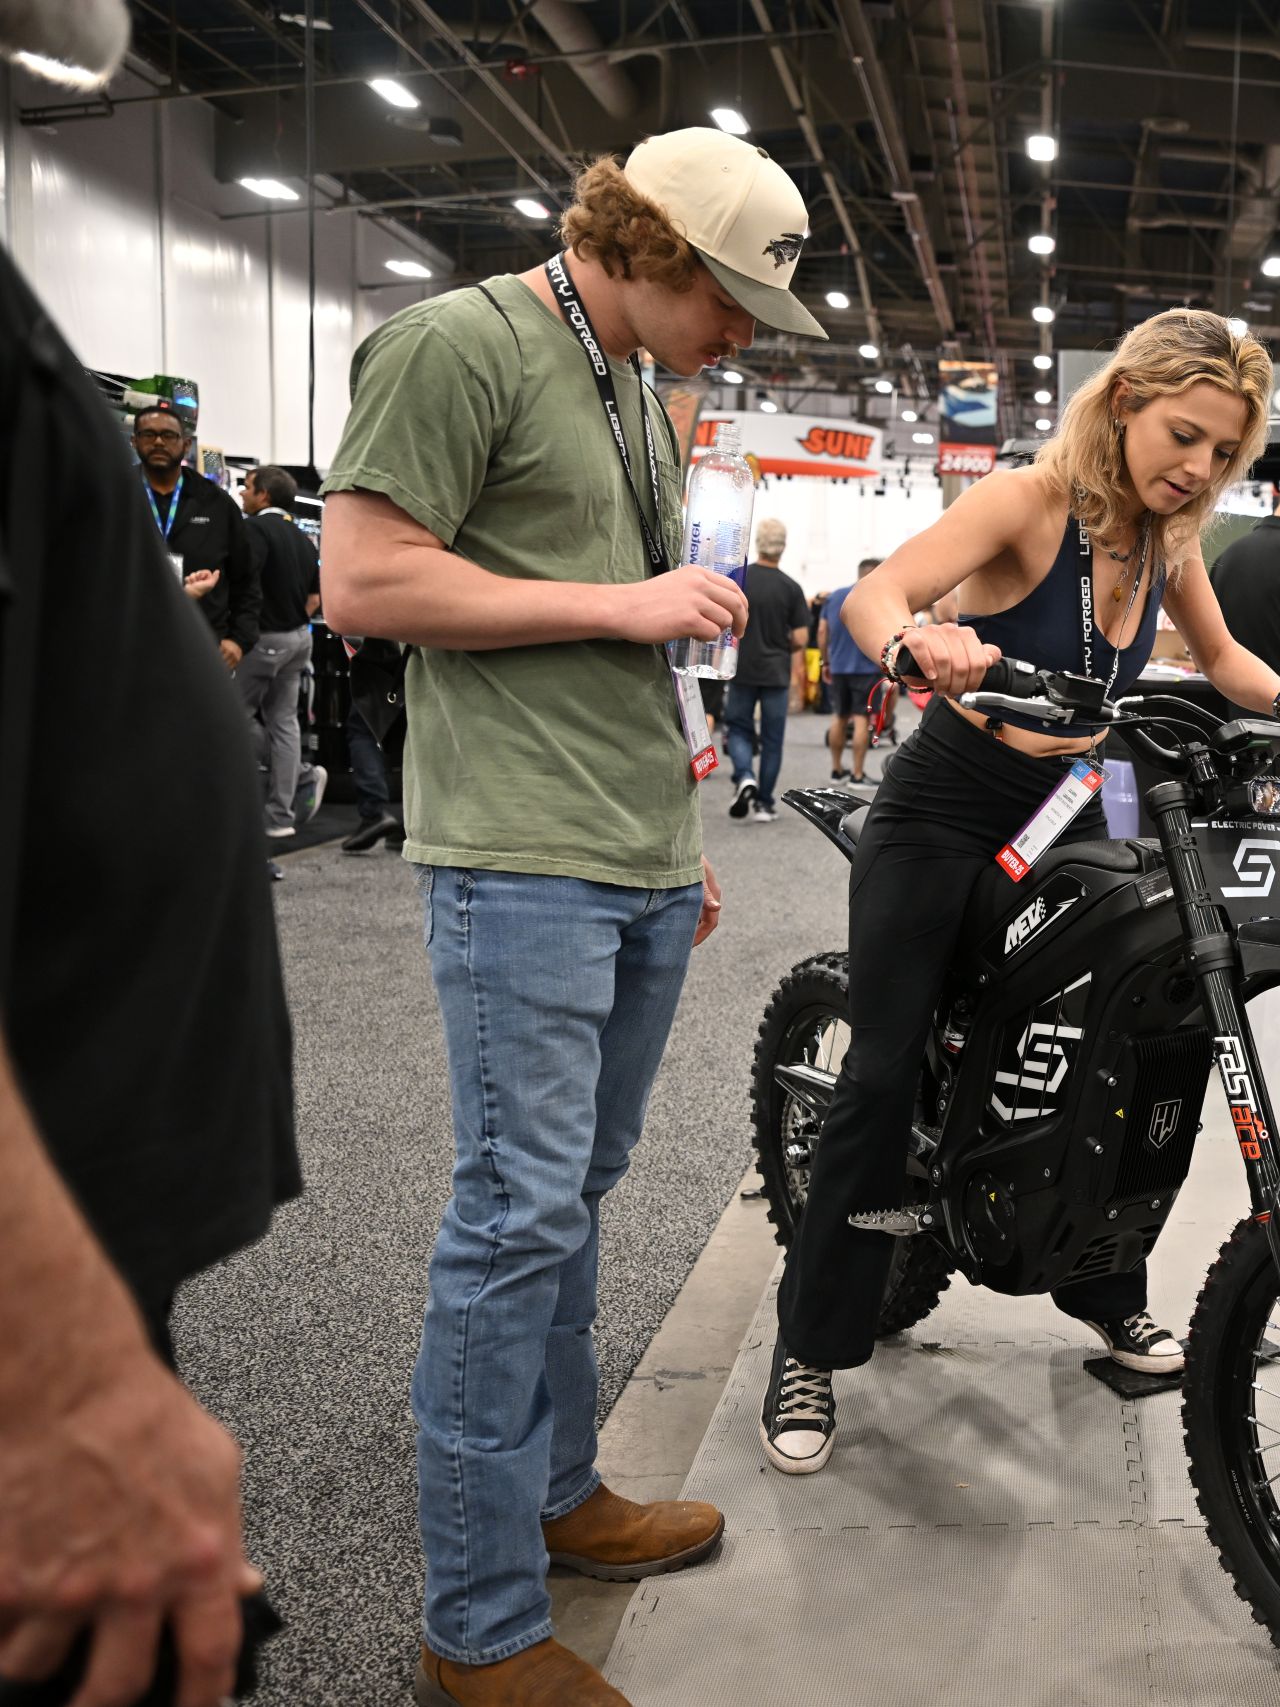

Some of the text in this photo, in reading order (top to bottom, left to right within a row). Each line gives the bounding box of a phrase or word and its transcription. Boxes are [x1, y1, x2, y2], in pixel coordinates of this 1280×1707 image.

[564, 300, 607, 375] FORGED
[1081, 576, 1092, 642] FORGED
[1211, 820, 1276, 831] ELECTRIC POWER
